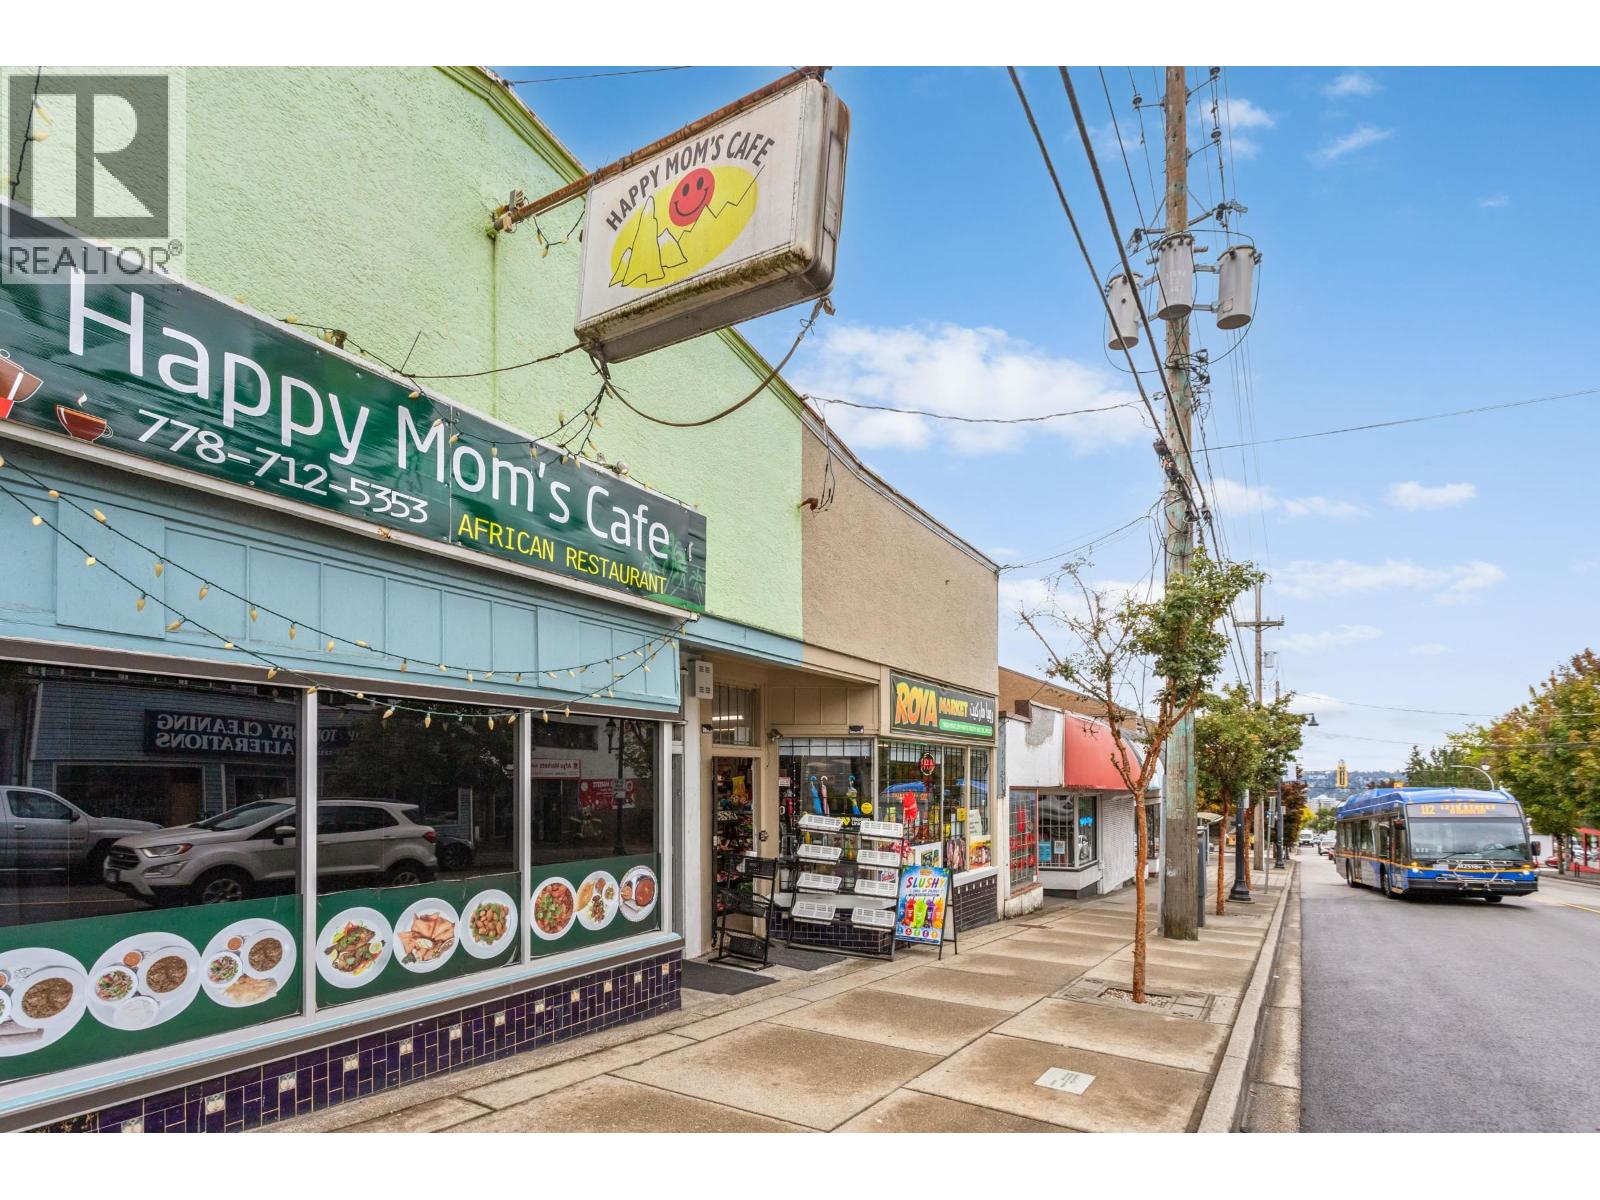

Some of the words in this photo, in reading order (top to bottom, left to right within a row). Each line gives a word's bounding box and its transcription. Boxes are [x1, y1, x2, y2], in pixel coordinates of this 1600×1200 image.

[605, 170, 660, 231] HAPPY
[665, 134, 724, 180] MOM'S
[726, 131, 775, 167] CAFE
[69, 266, 370, 466] Happy
[398, 405, 571, 524] Mom's
[586, 485, 670, 560] Cafe
[138, 409, 429, 524] 778-712-5353
[458, 513, 554, 563] AFRICAN
[566, 546, 667, 595] RESTAURANT
[895, 682, 938, 727] ROYA
[939, 697, 968, 717] MARKET
[906, 876, 946, 889] SLUSHY
